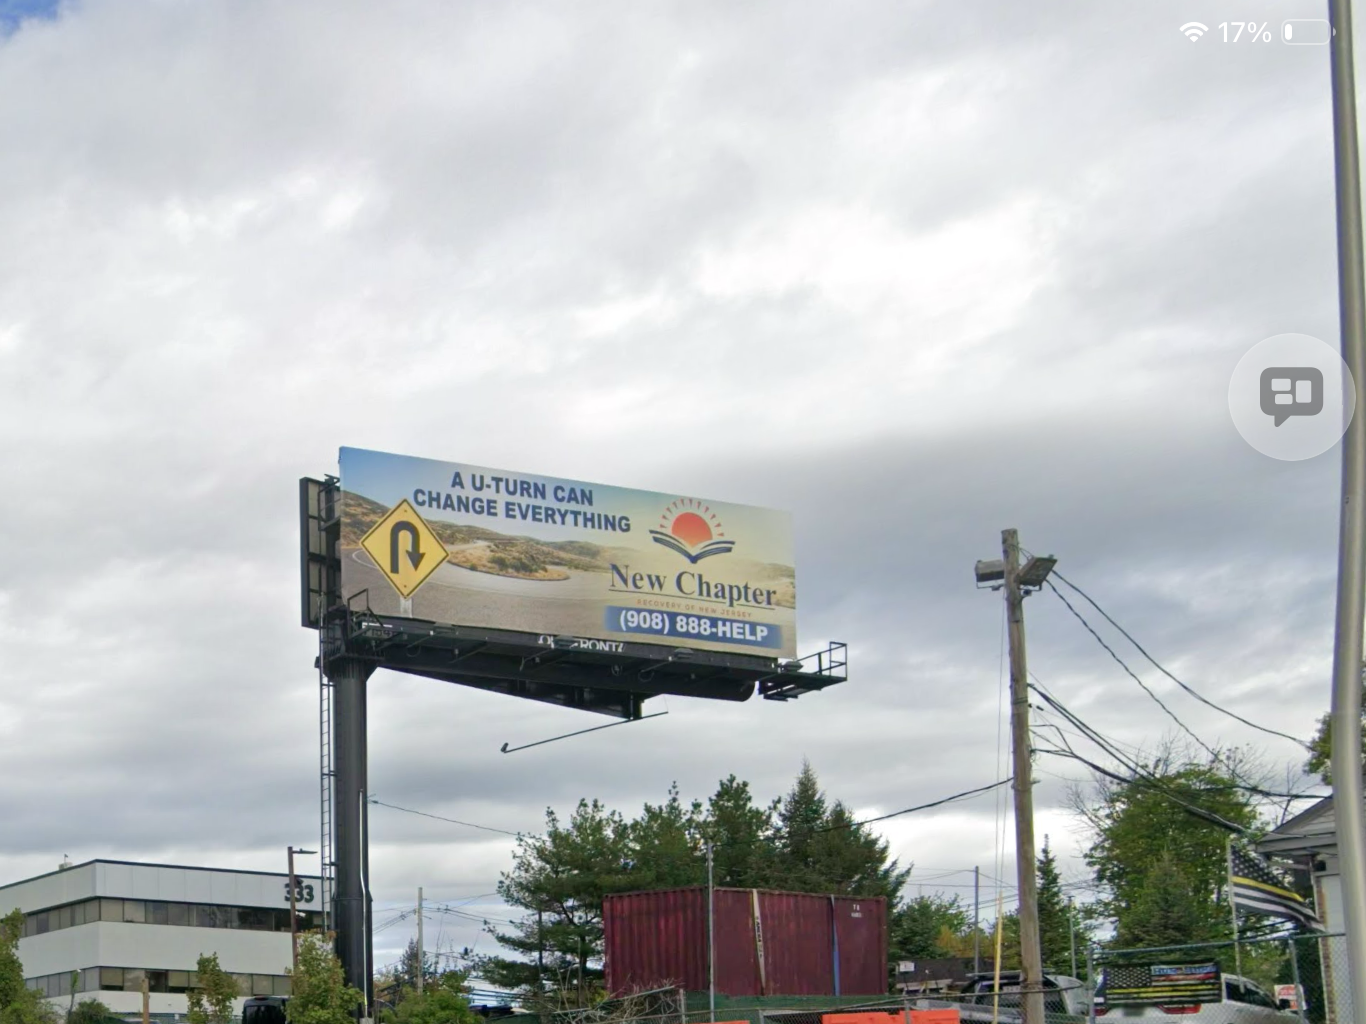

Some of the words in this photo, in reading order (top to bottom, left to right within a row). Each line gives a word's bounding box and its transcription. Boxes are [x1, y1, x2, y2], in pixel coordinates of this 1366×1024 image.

[451, 471, 465, 490] A
[471, 474, 546, 500] U-TURN
[553, 485, 594, 507] CAN
[413, 488, 498, 517] CHANGE
[504, 501, 631, 533] EVERYTHING
[609, 563, 667, 592] New
[676, 570, 777, 607] Chapter
[636, 598, 682, 611] RECOVERY
[684, 604, 696, 612] OF
[699, 606, 718, 614] NEW
[720, 609, 752, 618] JERSEY
[619, 609, 670, 635] (908)
[675, 615, 769, 642] 888-HELP
[284, 883, 314, 903] 333
